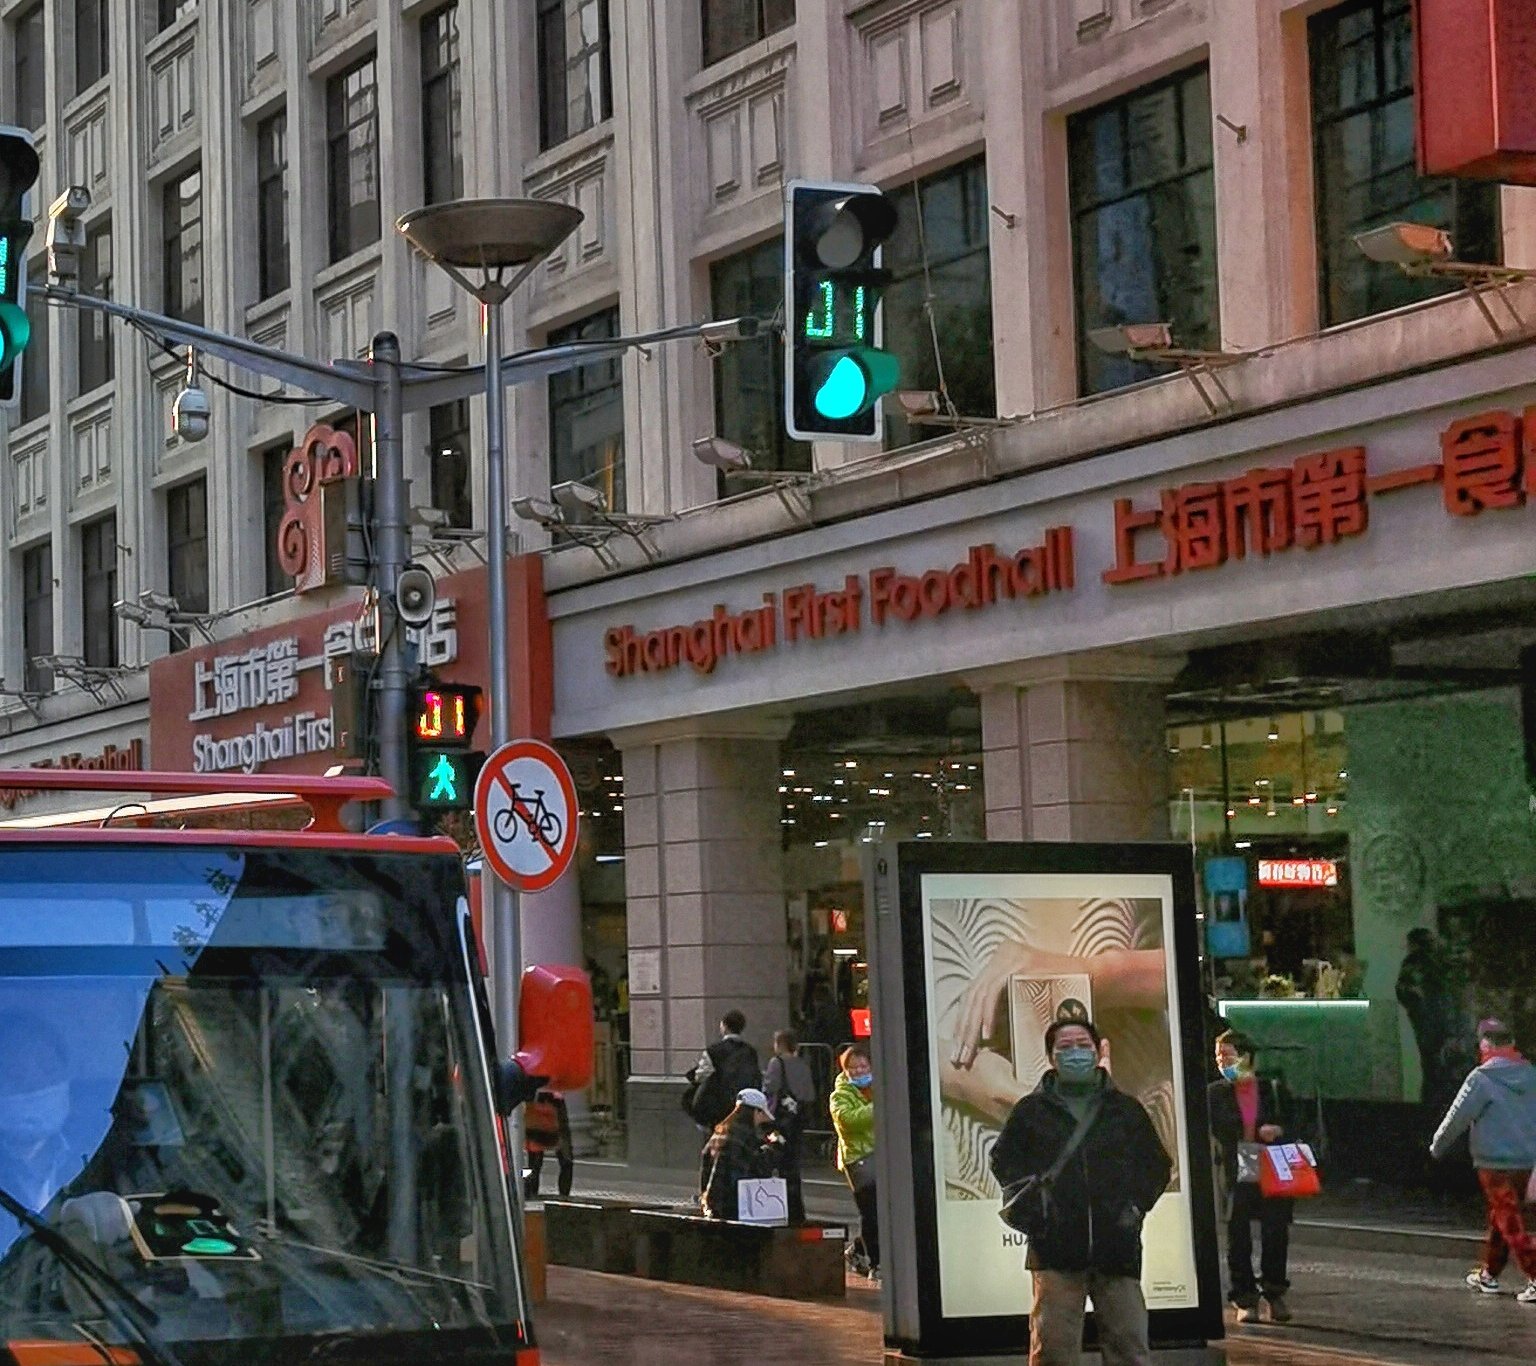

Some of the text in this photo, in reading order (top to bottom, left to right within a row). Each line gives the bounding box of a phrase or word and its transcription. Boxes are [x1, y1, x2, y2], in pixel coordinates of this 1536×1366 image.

[1102, 403, 1536, 585] 上海市第一食
[604, 525, 1076, 678] Shanghai First Foodhall
[192, 716, 294, 775] Shanghai
